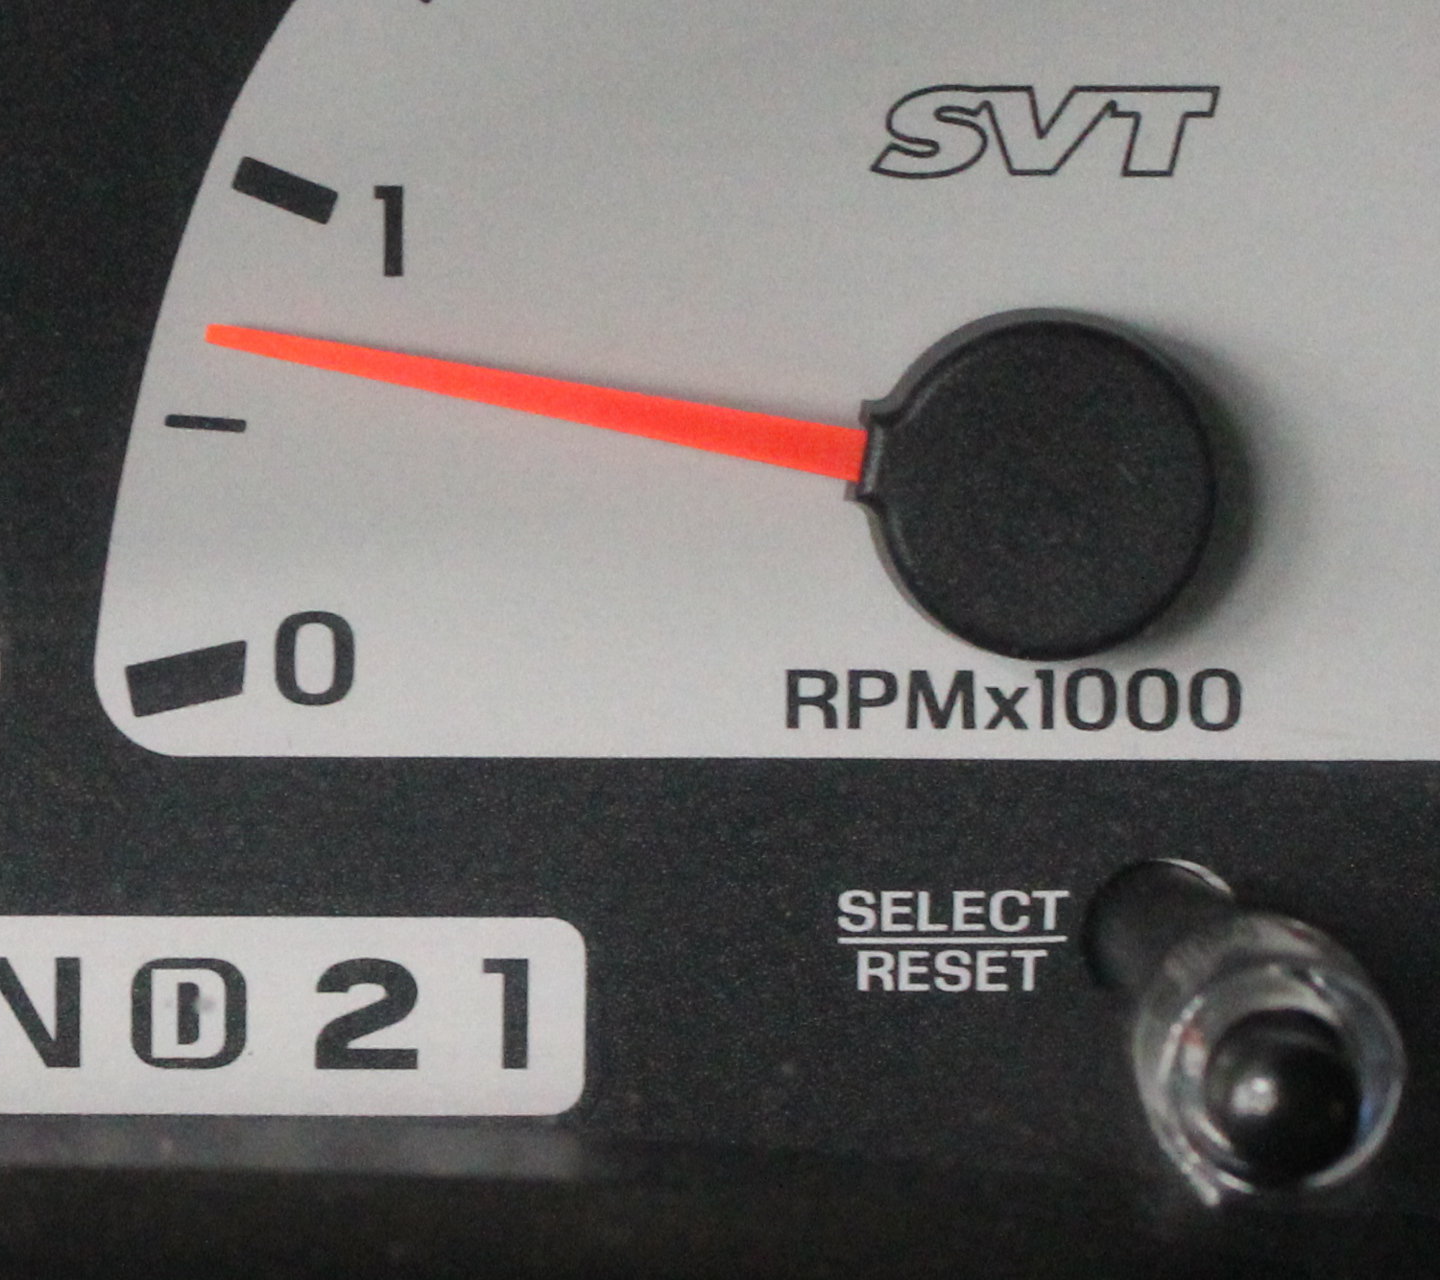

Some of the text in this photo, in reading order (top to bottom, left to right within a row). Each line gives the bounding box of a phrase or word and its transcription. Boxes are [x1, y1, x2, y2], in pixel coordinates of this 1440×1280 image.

[870, 84, 1220, 180] SVT
[374, 186, 404, 277] 1
[275, 611, 355, 706] 0
[787, 670, 1241, 731] RPMx1000
[838, 890, 1069, 932] SELECT
[315, 958, 418, 1070] 2
[484, 959, 528, 1069] 1
[858, 950, 1047, 992] RESET
